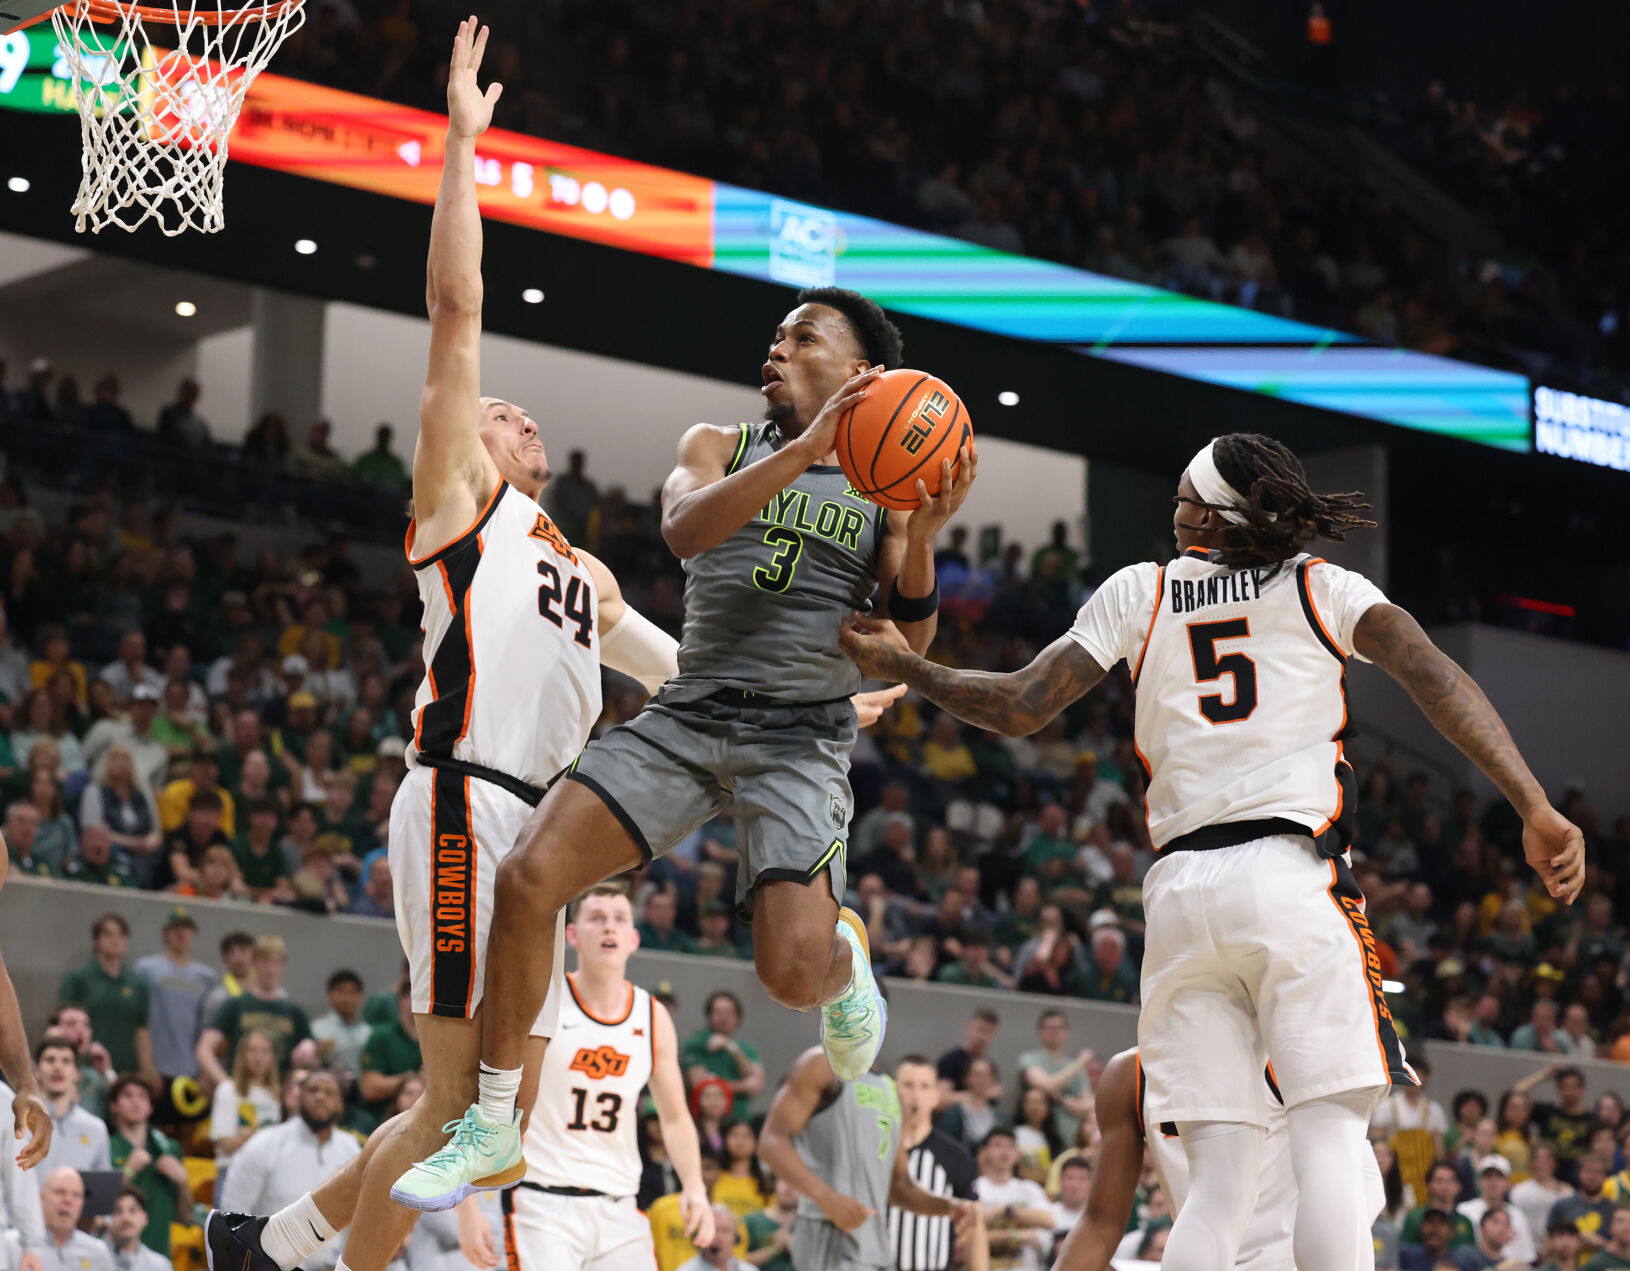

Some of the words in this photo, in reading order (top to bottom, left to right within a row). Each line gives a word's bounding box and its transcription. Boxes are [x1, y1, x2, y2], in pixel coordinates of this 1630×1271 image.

[900, 390, 950, 456] ELITE
[752, 525, 803, 594] 3
[1171, 568, 1261, 614] BRANTLEY
[536, 559, 593, 650] 24
[1186, 616, 1258, 725] 5
[436, 833, 467, 953] COWBOYS
[567, 1087, 622, 1133] 13
